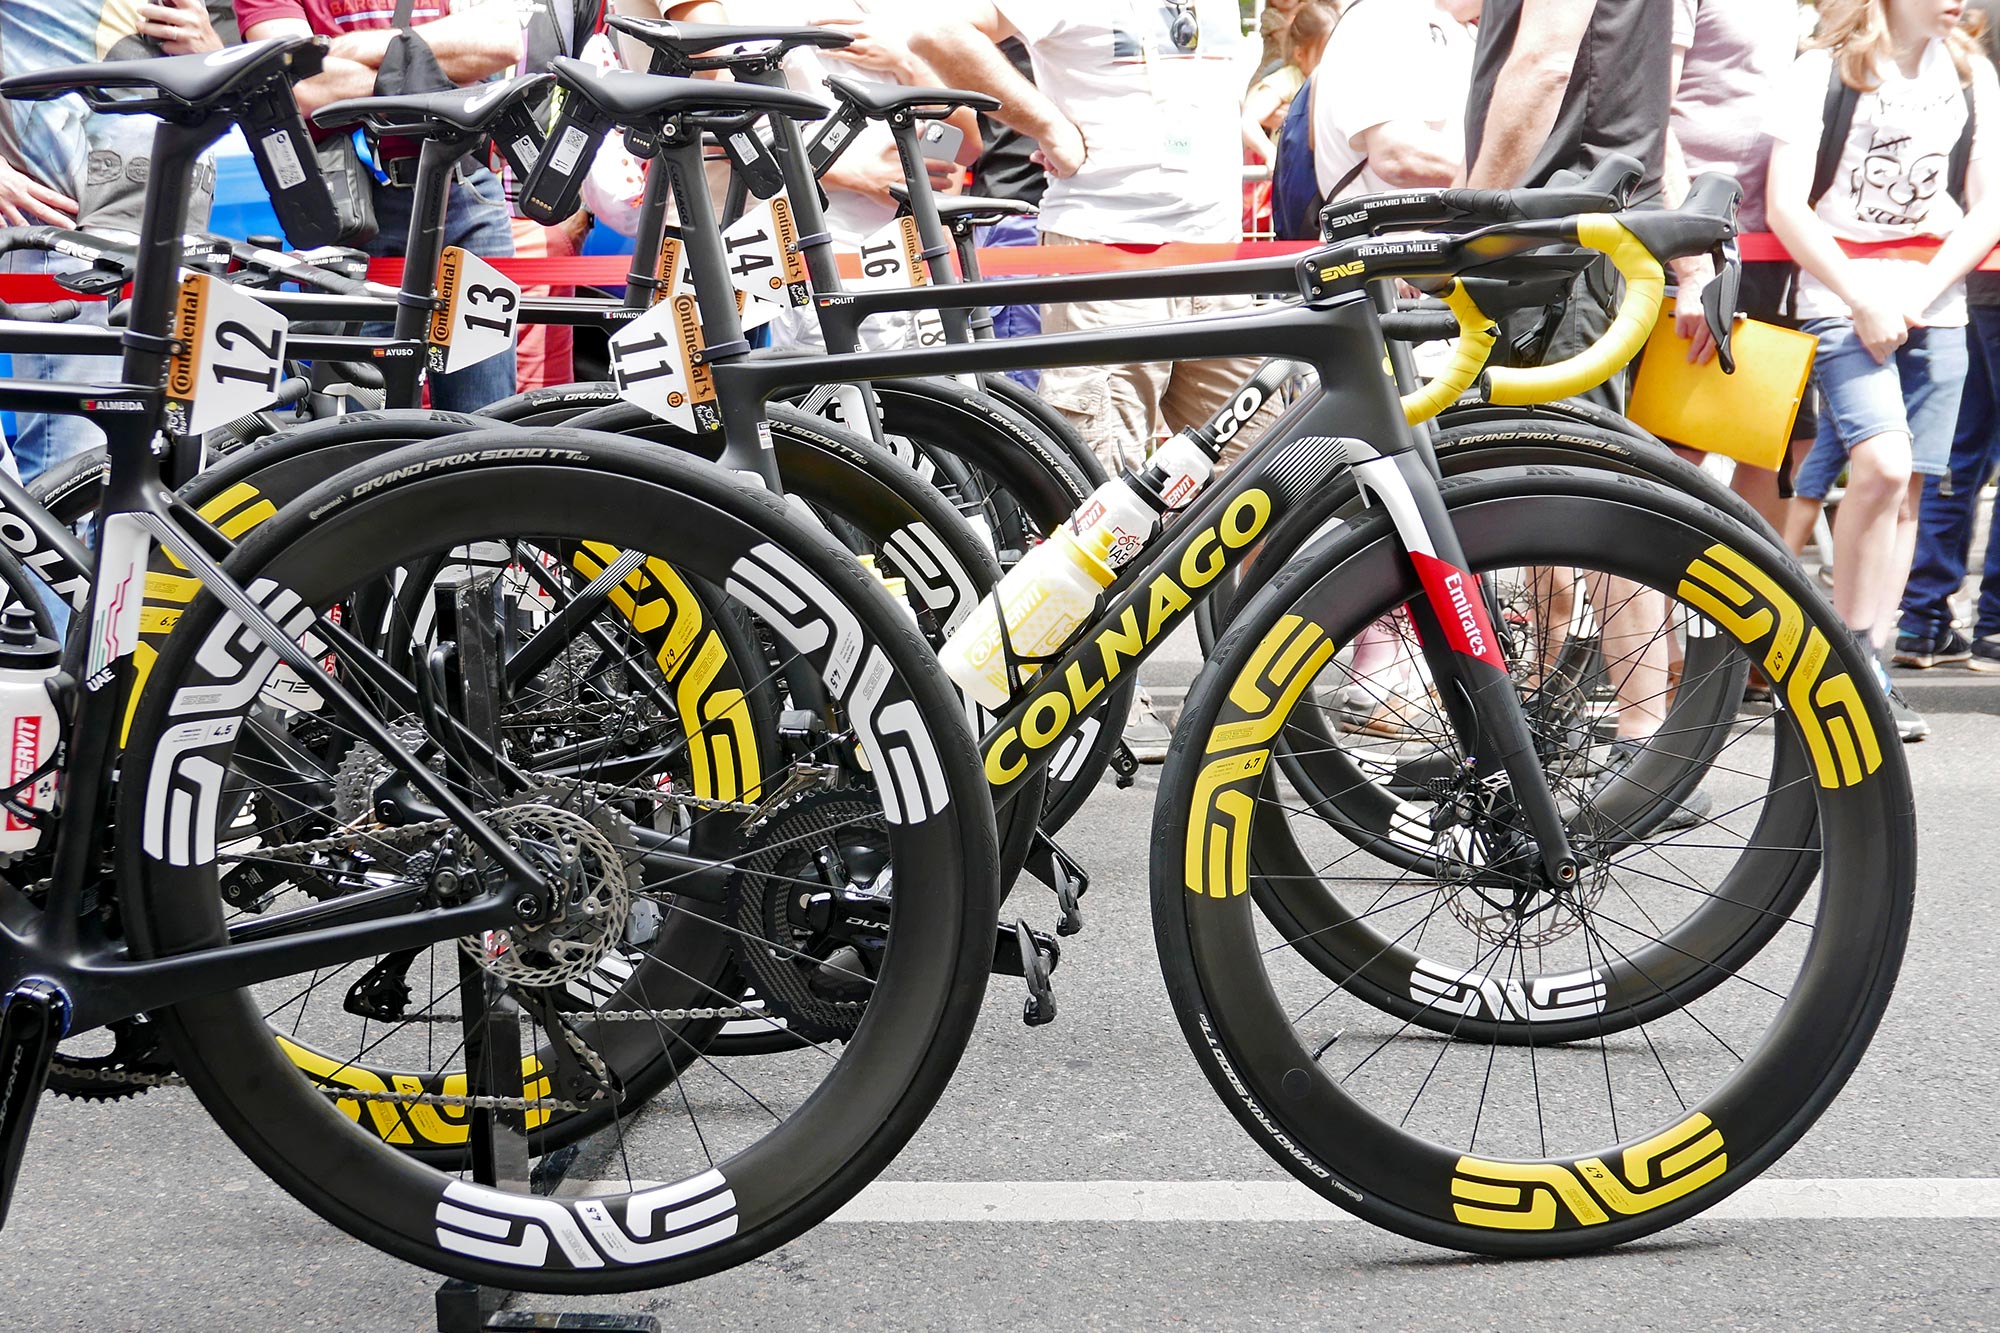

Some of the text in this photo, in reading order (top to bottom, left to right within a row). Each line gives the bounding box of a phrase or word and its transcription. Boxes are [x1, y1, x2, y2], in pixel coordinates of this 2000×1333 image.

[670, 164, 690, 225] COLNAGO
[1363, 195, 1427, 210] RICHARD MILLE
[724, 228, 774, 277] 14
[860, 239, 900, 278] 16
[1358, 243, 1438, 257] RICHARD MILLE
[464, 283, 516, 338] 13
[212, 320, 283, 393] 12
[386, 348, 414, 357] AYUSO
[611, 332, 675, 392] 11
[96, 401, 145, 411] ALMEIDA
[563, 392, 616, 401] GRAND
[788, 425, 839, 449] 5000
[838, 444, 865, 461] TT
[1458, 432, 1515, 446] GRAND
[1514, 431, 1557, 441] PRIX
[1555, 433, 1604, 448] 5000
[352, 463, 424, 499] GRAND
[422, 451, 481, 472] PRIX
[481, 448, 547, 461] 5000
[548, 448, 583, 460] TT
[44, 478, 80, 503] GRAND
[1444, 571, 1487, 656] Emirates
[985, 487, 1272, 787] COLNAGO
[1773, 650, 1784, 671] 6.7
[86, 668, 115, 692] UAE
[830, 668, 842, 689] 4.5
[213, 724, 232, 736] 4.5
[1243, 757, 1261, 770] 6.7
[1199, 1019, 1219, 1048] TT
[1211, 1047, 1250, 1097] 5000
[1241, 1096, 1282, 1135] PRIX
[1273, 1132, 1331, 1179] GRAND
[1585, 1165, 1603, 1180] 6.7
[585, 1206, 603, 1222] 4.5
